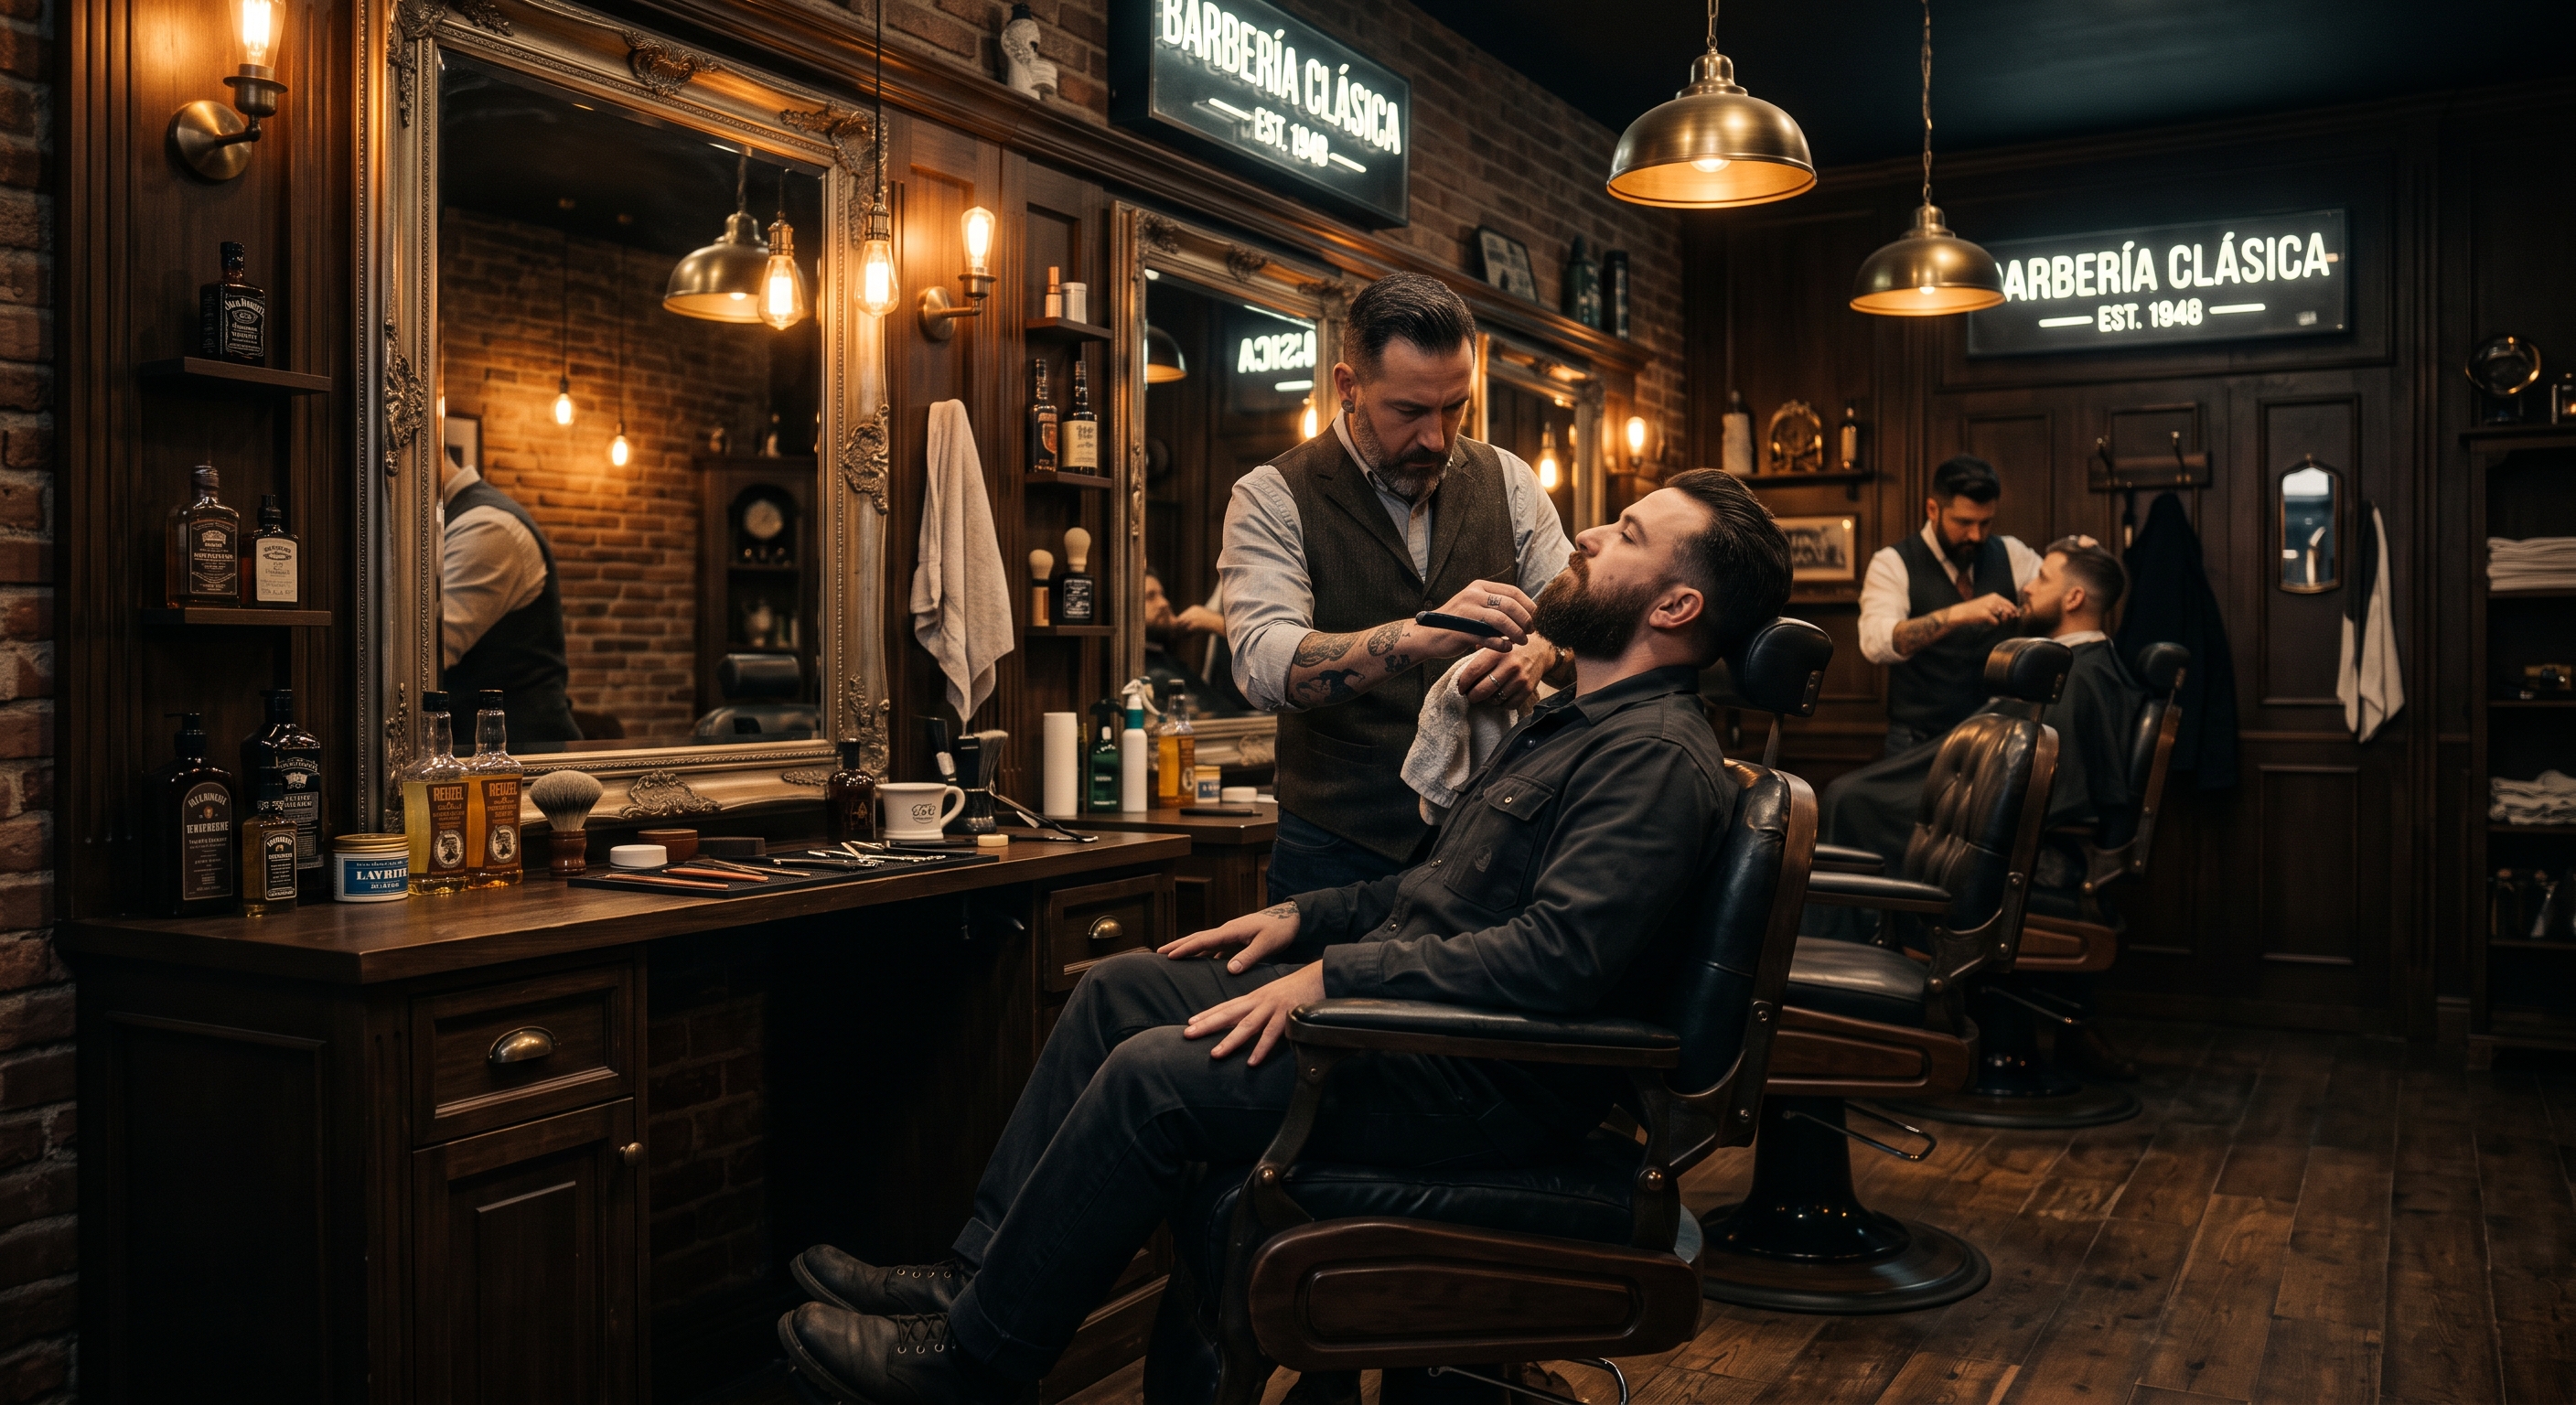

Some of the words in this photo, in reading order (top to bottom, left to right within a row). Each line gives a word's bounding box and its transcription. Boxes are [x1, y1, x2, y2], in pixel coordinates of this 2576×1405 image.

[1163, 0, 1299, 105] BARBERÍA
[1305, 59, 1401, 156] CLÁSICA
[1254, 106, 1288, 153] EST.
[1995, 240, 2158, 303] ARBERÍA
[2168, 231, 2331, 290] CLÁSICA
[2098, 303, 2143, 333] EST.
[2148, 298, 2204, 328] 1948
